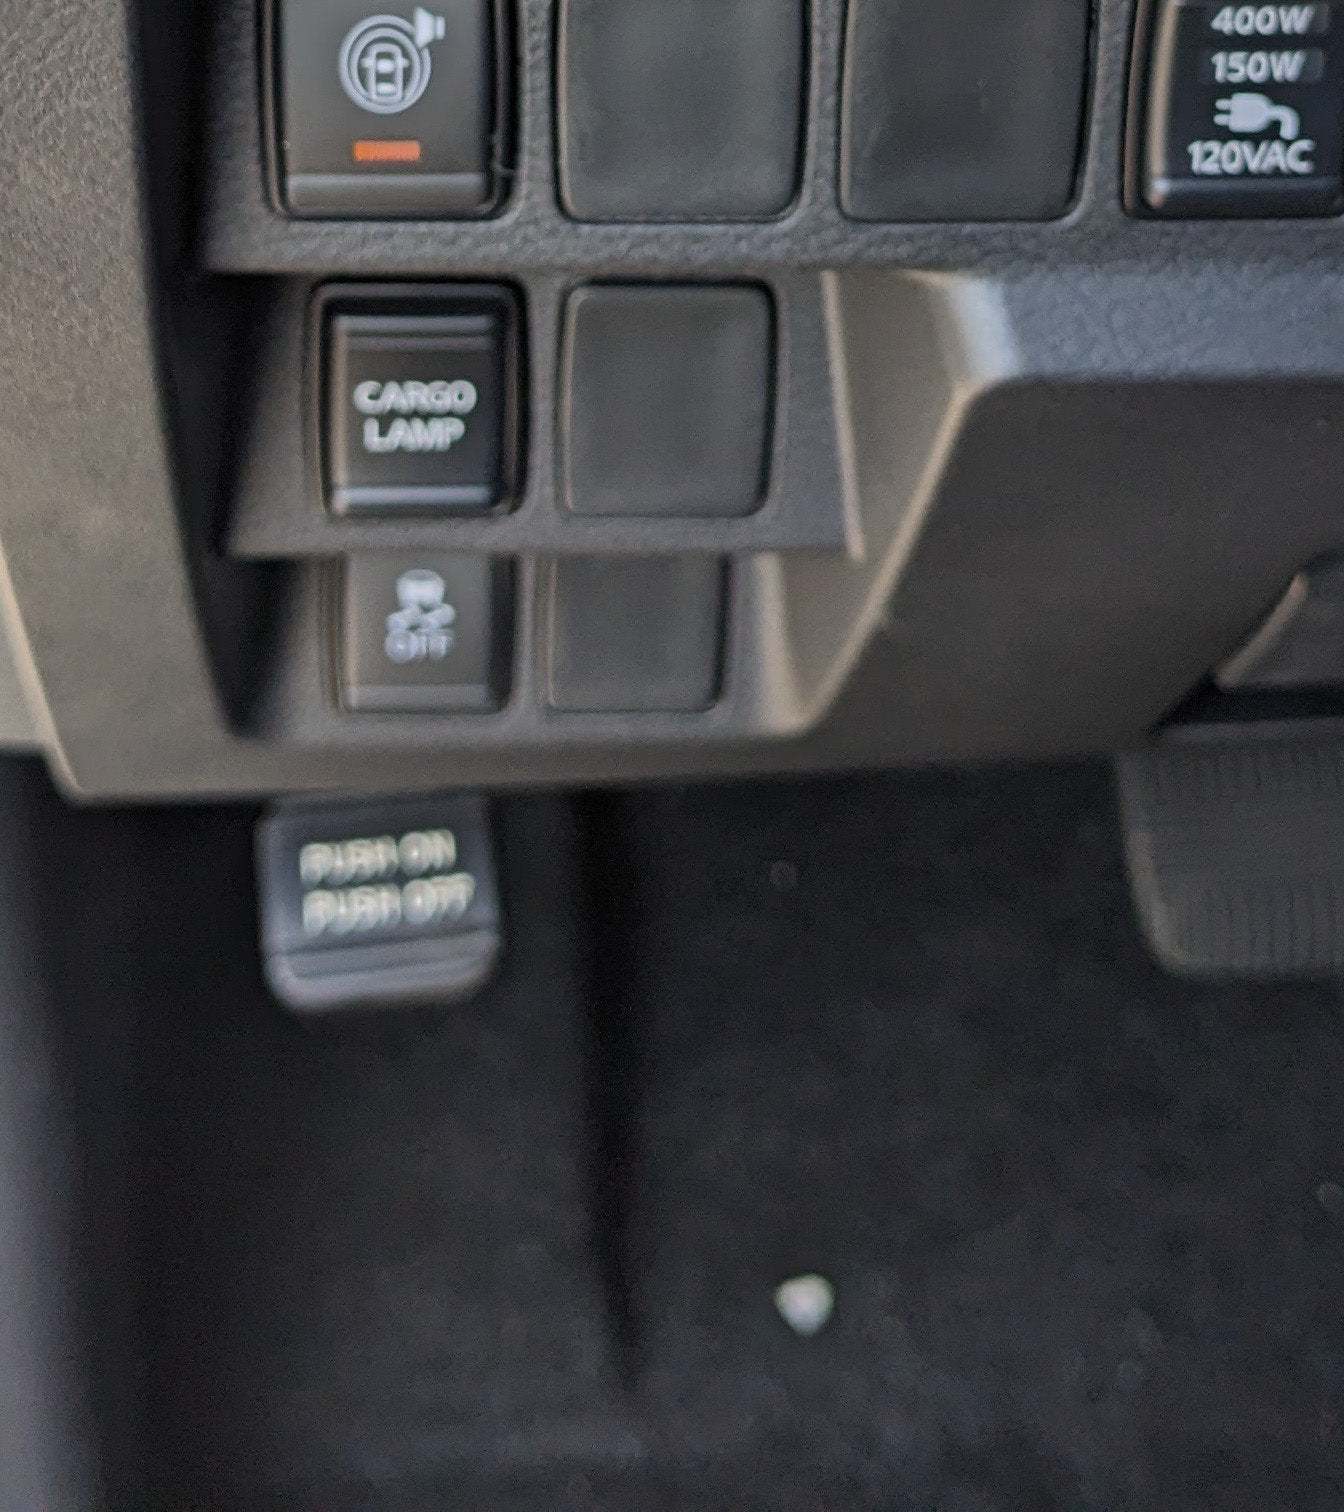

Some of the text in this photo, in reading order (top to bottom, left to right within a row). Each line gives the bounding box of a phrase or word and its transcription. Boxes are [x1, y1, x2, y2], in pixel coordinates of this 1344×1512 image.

[1210, 5, 1316, 35] 400W
[1211, 50, 1307, 83] 150W
[1187, 139, 1316, 175] 120VAC
[353, 380, 477, 415] CARGO
[362, 417, 466, 452] LAMP
[385, 629, 454, 663] OFF
[299, 829, 456, 888] PUSH ON
[303, 872, 476, 937] PUSH OFF
